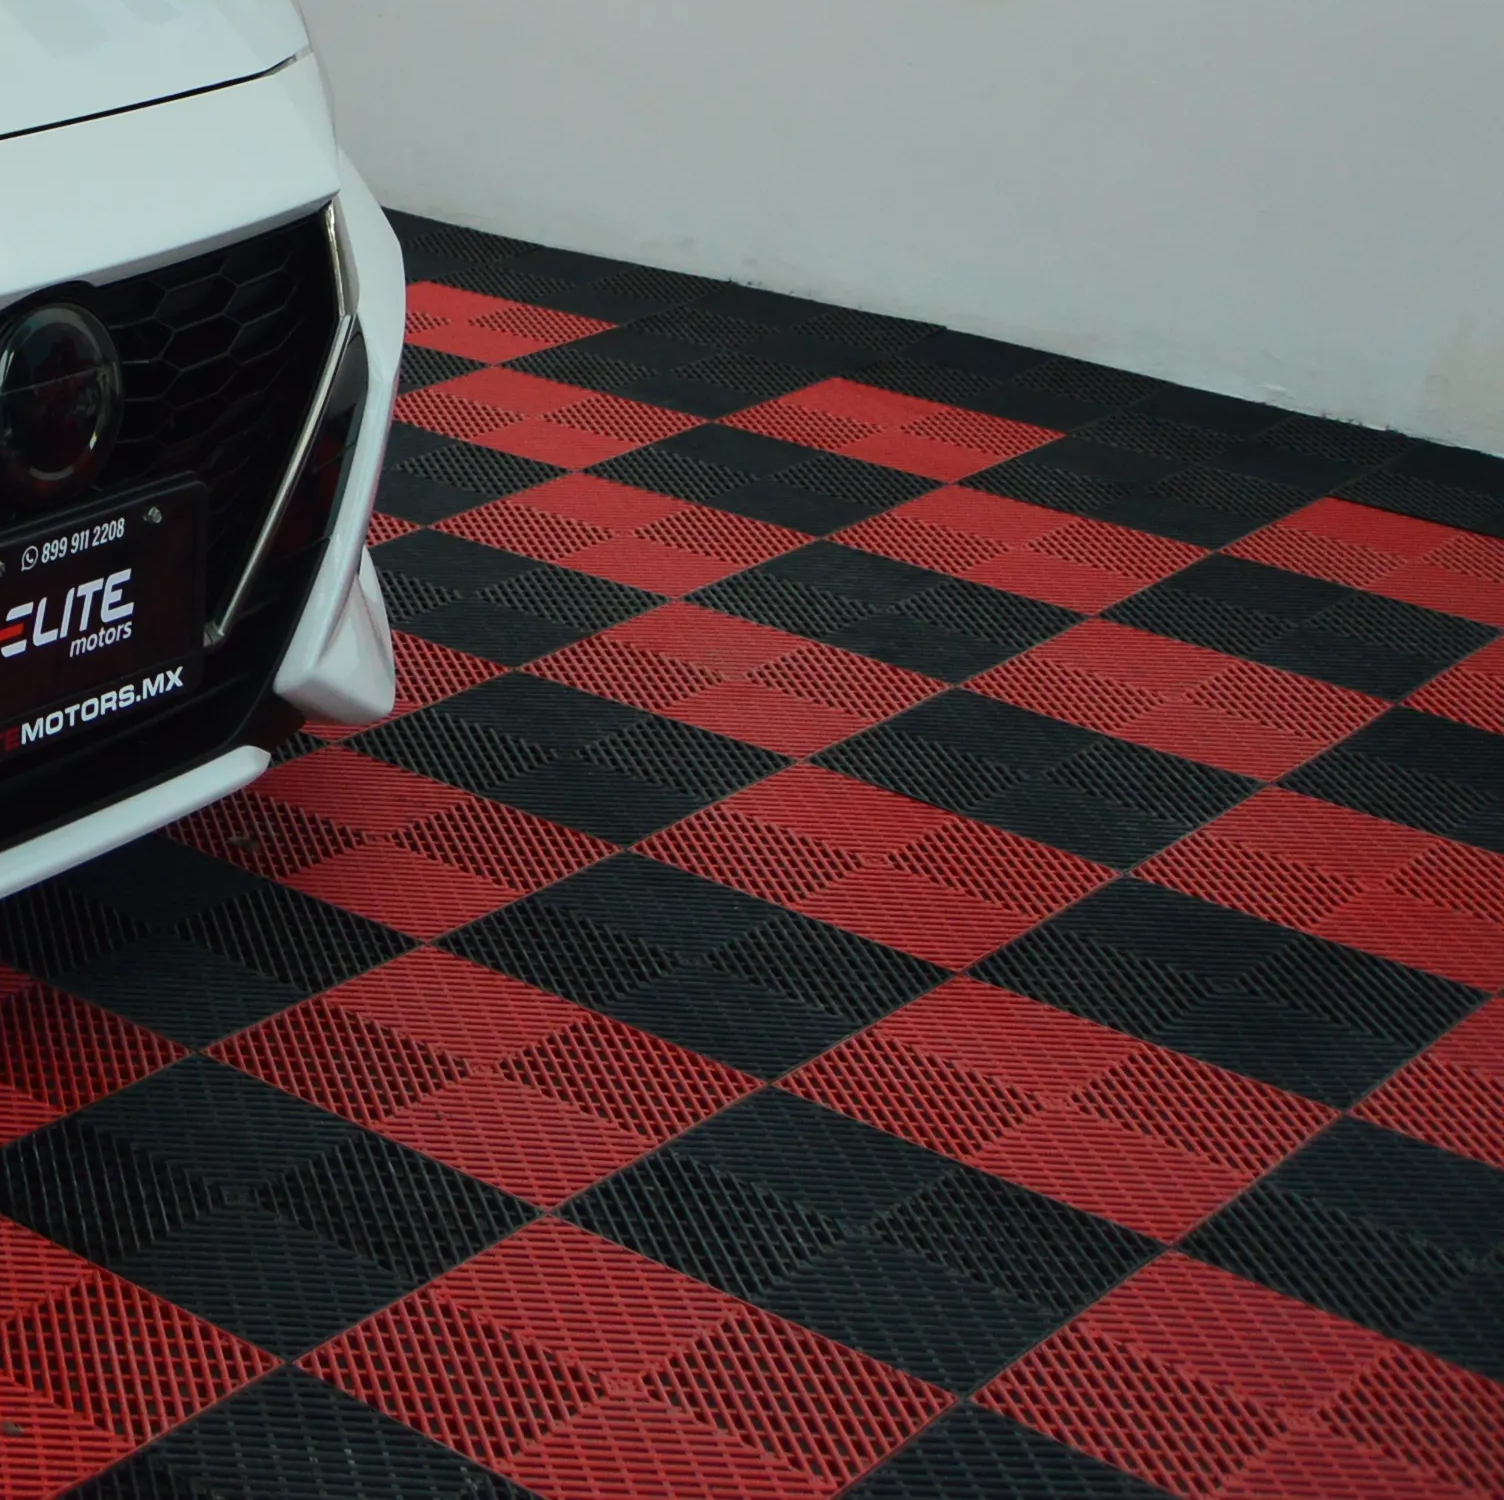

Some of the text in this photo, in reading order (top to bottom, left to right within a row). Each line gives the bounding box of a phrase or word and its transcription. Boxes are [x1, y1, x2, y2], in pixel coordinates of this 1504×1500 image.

[41, 517, 125, 564] 899 911 2208
[69, 621, 133, 658] motors
